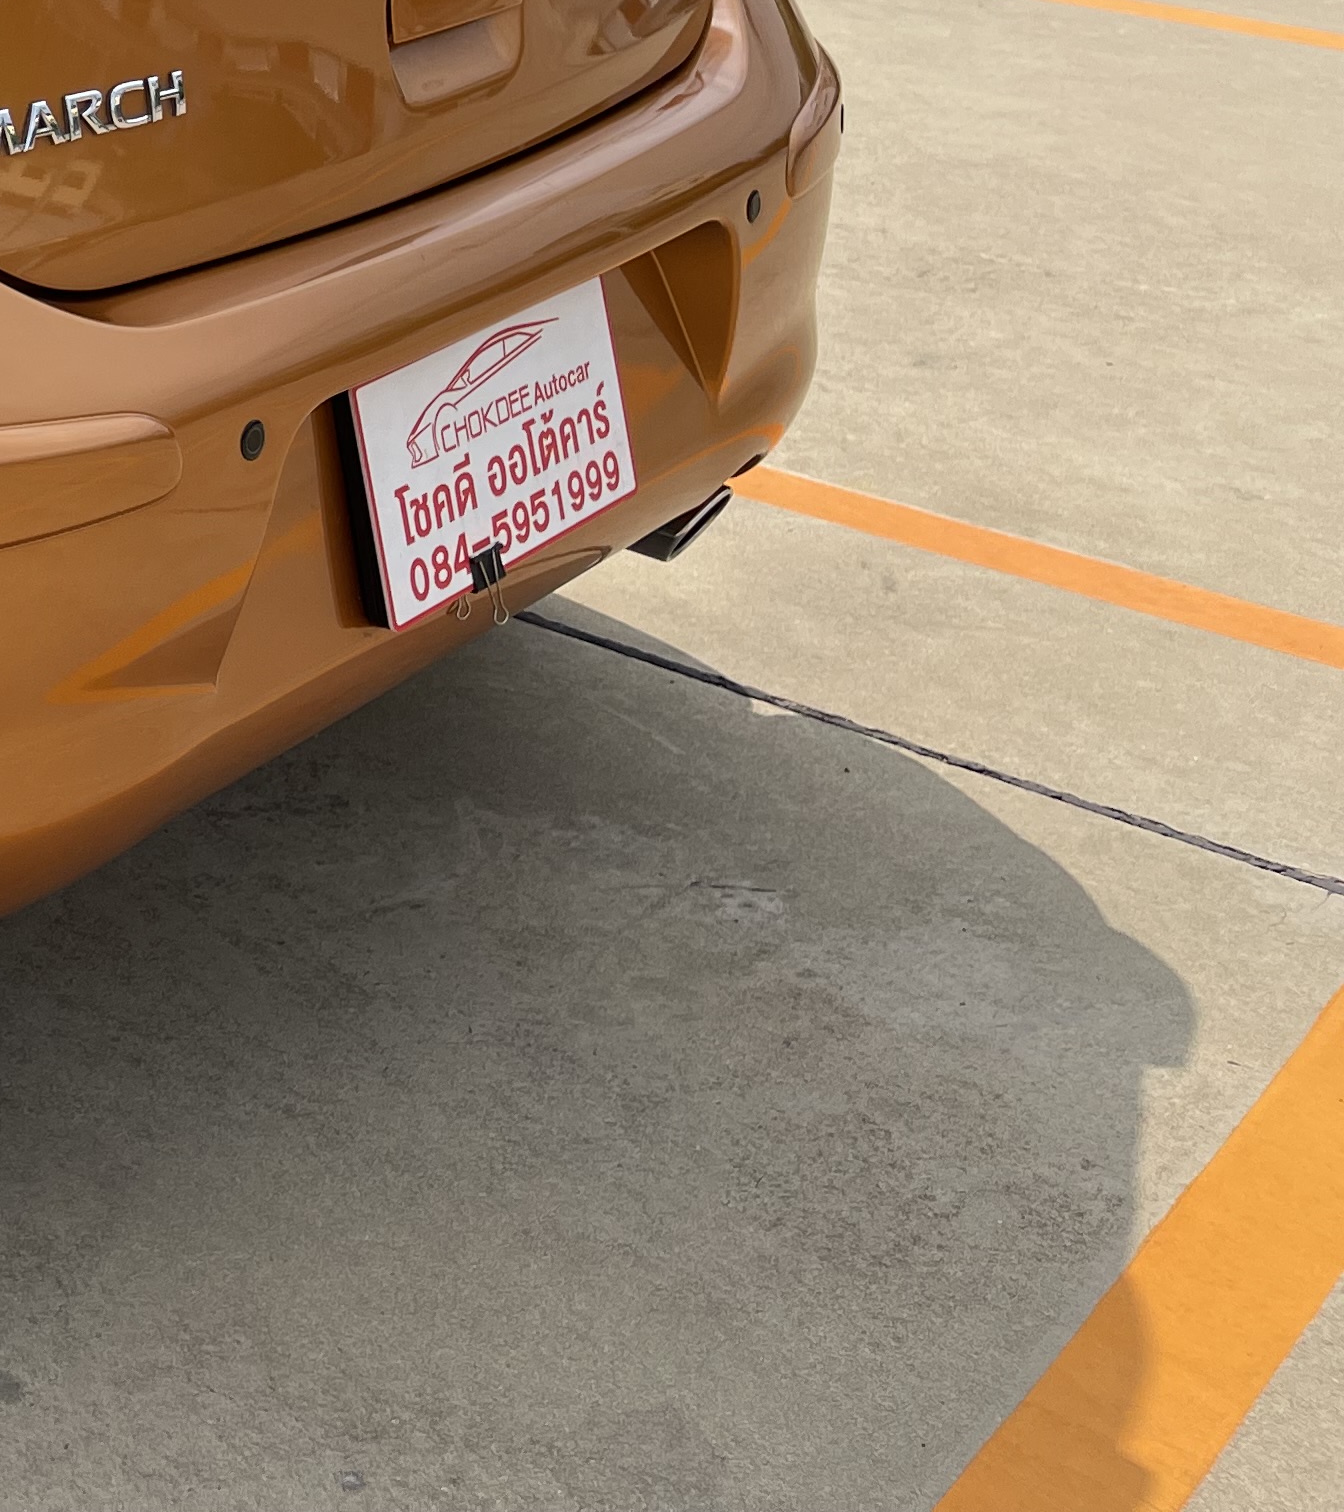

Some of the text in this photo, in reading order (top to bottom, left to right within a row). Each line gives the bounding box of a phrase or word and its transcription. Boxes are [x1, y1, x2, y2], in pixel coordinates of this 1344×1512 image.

[394, 380, 611, 546] โชคดี ออโต้คาร์
[440, 360, 591, 453] CHOKDEE Autocar
[409, 450, 620, 601] 084-5951999
